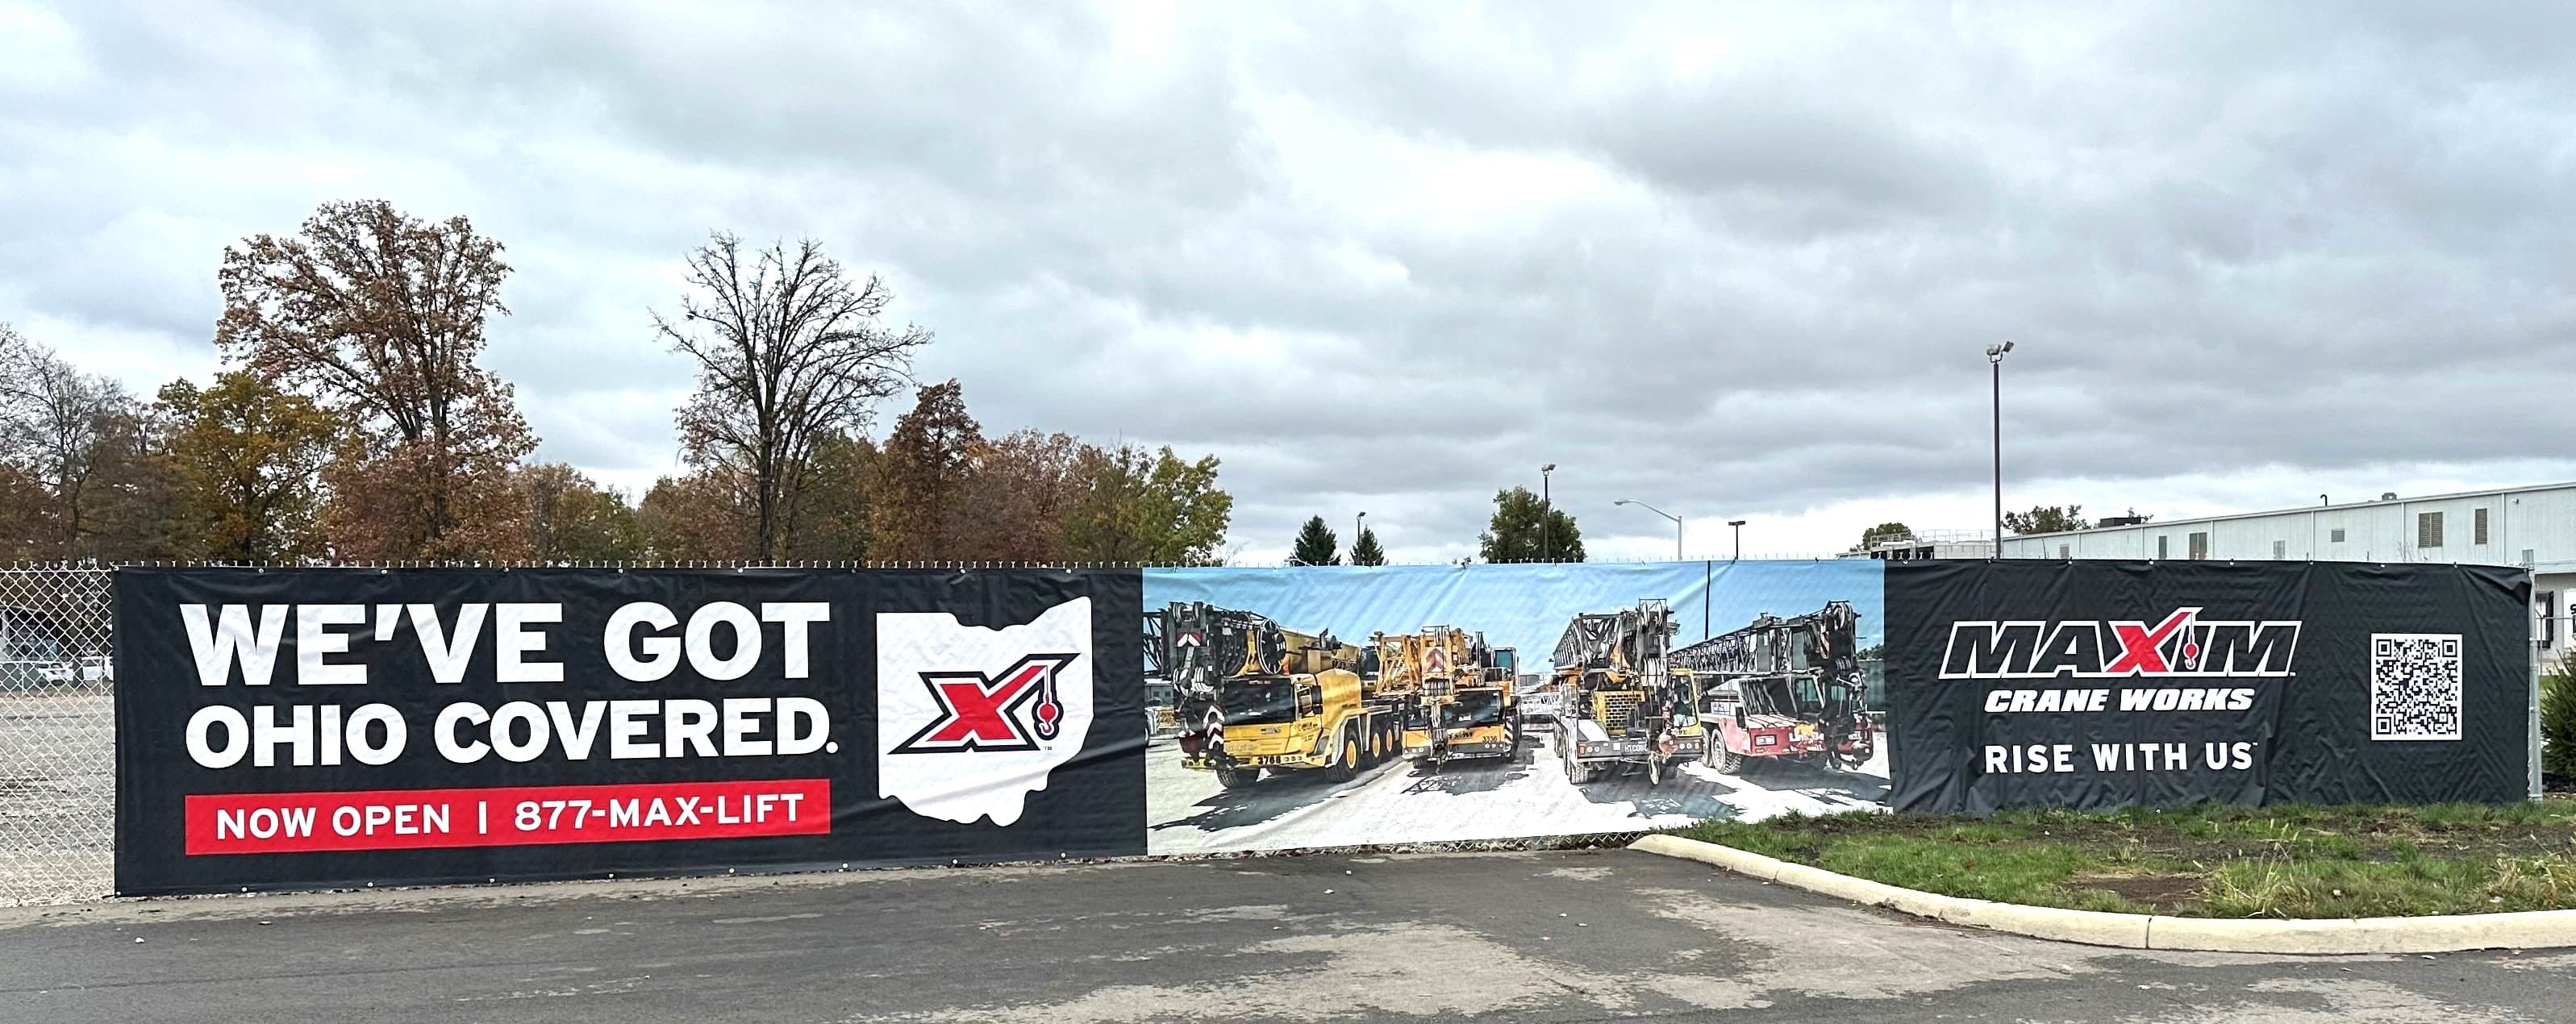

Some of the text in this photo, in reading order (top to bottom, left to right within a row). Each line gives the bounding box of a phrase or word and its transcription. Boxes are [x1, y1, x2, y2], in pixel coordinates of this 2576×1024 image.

[180, 601, 830, 686] WE'VE GOT
[1938, 606, 2303, 680] MAXIM
[1984, 688, 2255, 713] CRANE WORKS
[185, 697, 839, 768] OHIO COVERED.
[1985, 742, 2253, 773] RISE WITH US
[217, 807, 317, 839] NOW
[332, 804, 449, 836] OPEN
[515, 793, 804, 831] 877-MAX-LIFT
